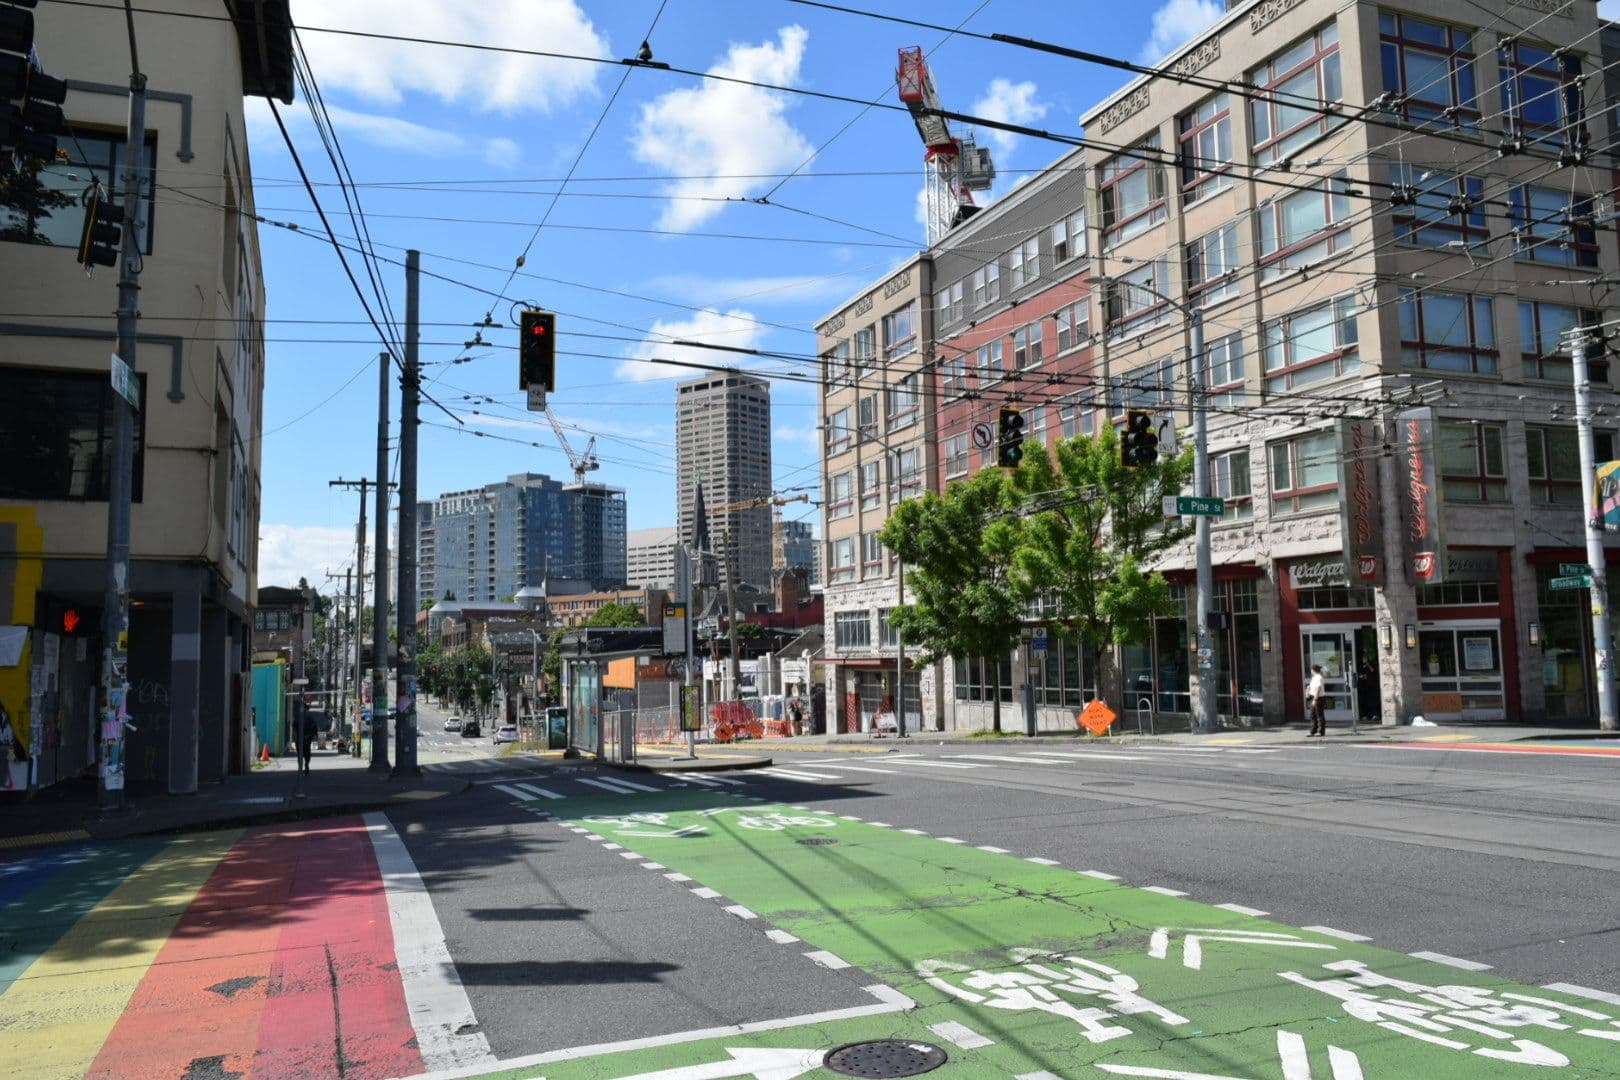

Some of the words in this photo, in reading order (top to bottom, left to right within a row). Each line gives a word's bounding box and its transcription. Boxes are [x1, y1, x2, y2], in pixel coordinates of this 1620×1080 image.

[1407, 417, 1432, 542] Walgreens
[1190, 500, 1209, 512] Pine
[1291, 561, 1345, 583] Walgree
